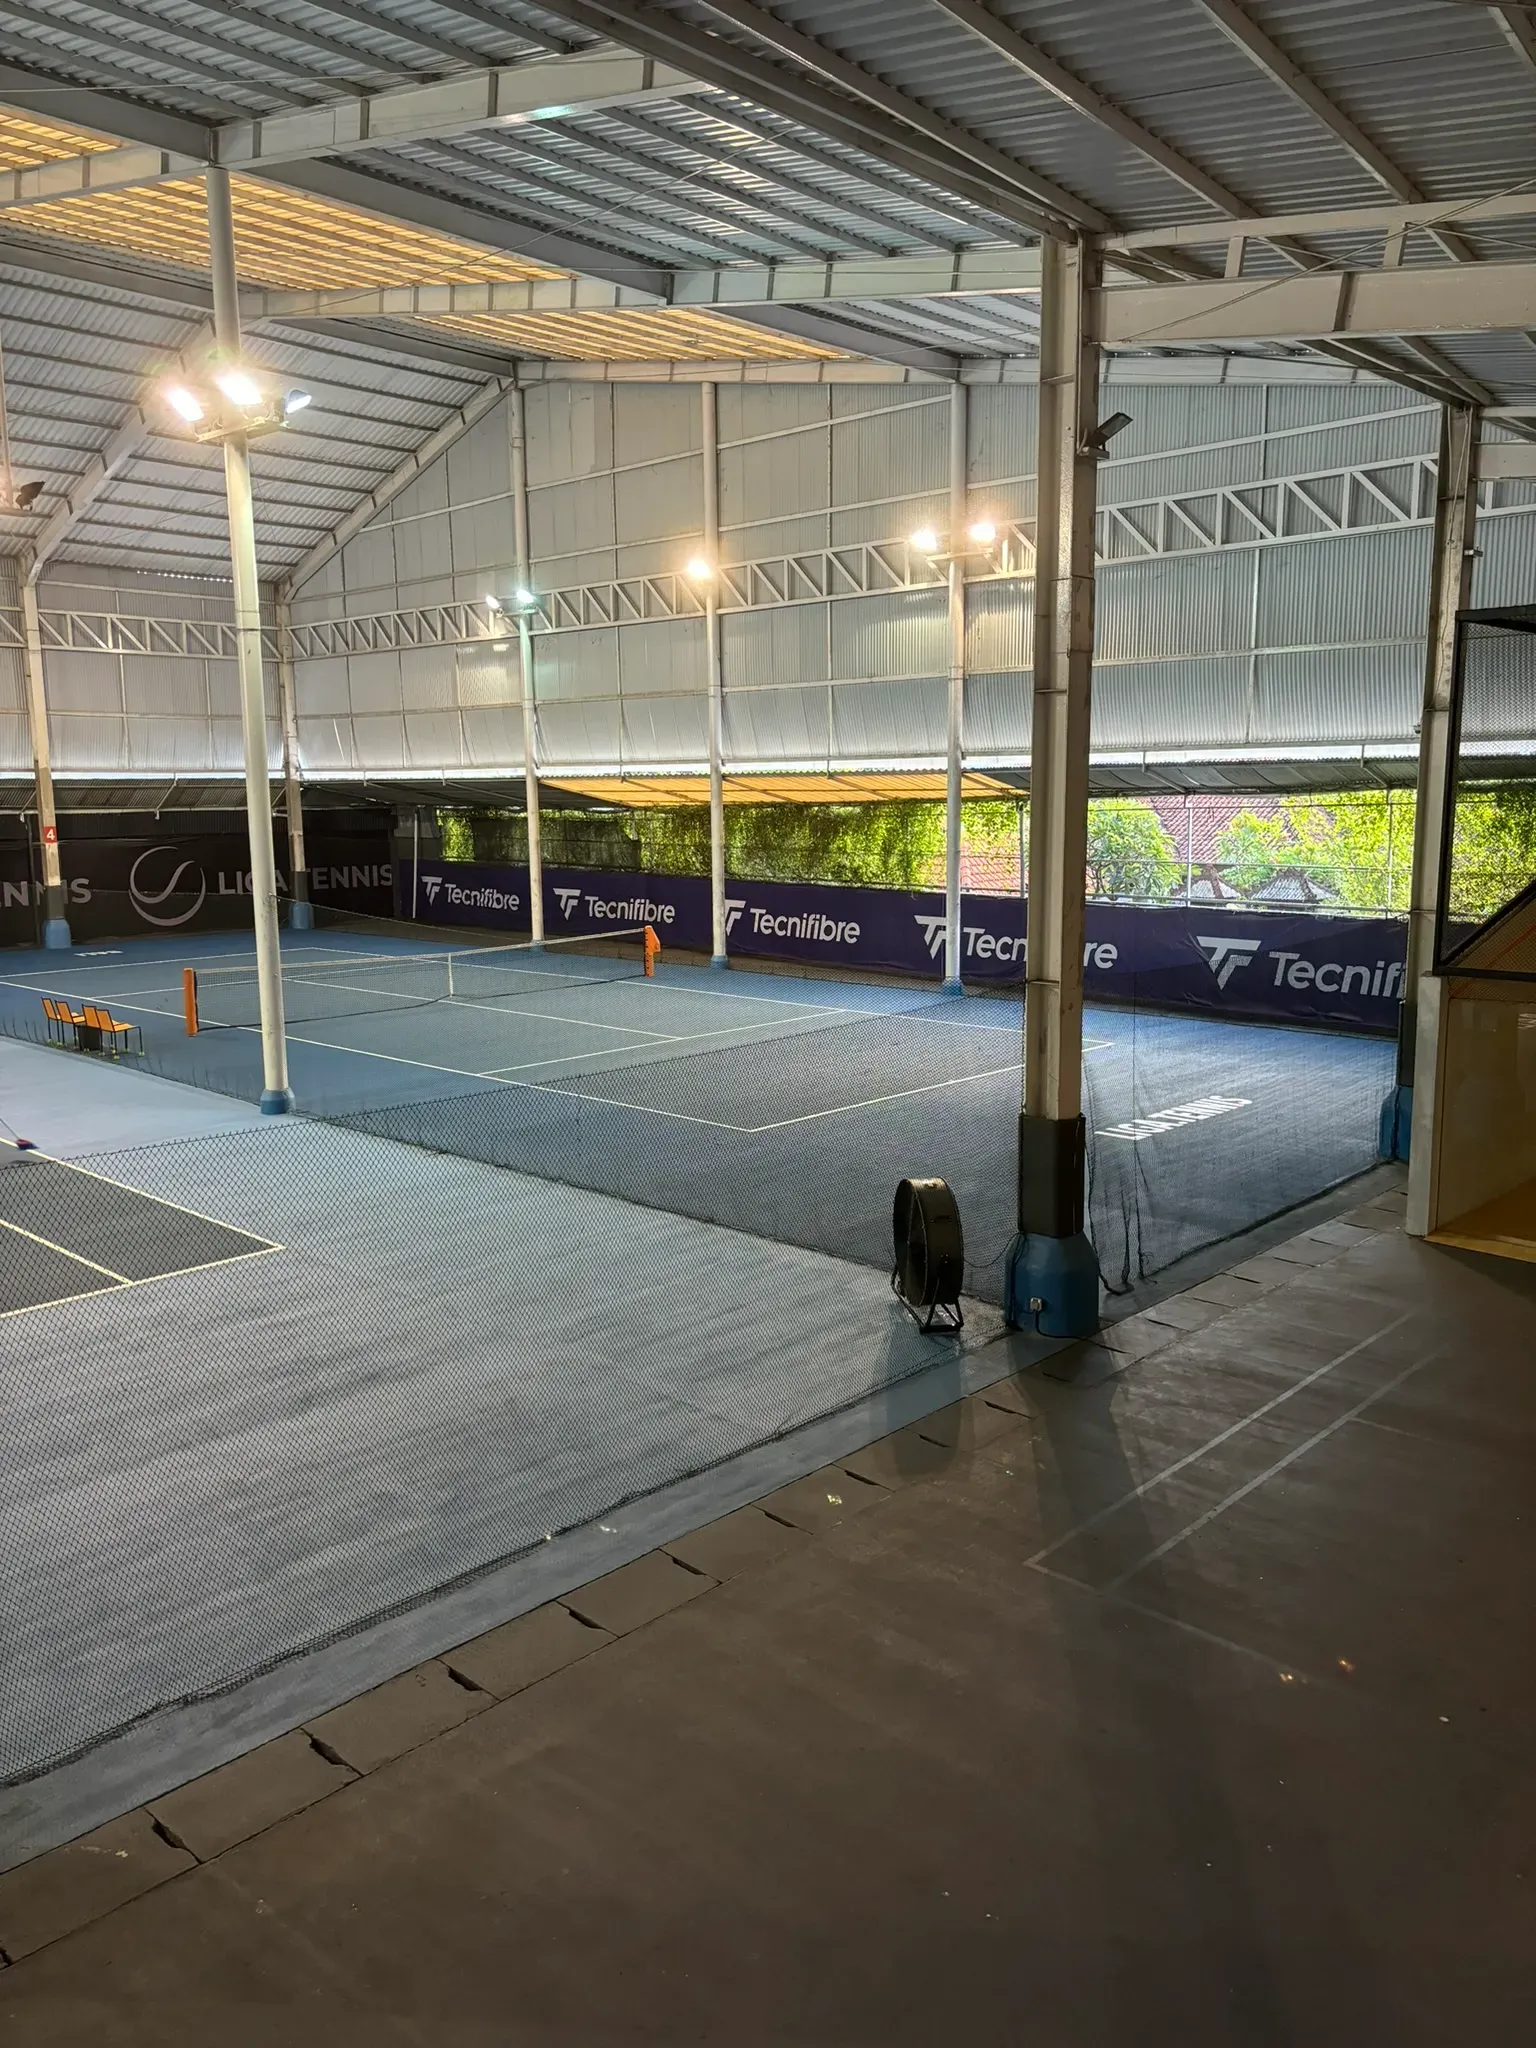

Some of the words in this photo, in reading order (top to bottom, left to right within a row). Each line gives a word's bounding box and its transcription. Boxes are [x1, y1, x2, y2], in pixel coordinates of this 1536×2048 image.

[46, 828, 56, 841] 4
[444, 883, 520, 911] Tecnifibre
[584, 895, 676, 924] Tecnifibre
[750, 908, 861, 944] Tecnifibre
